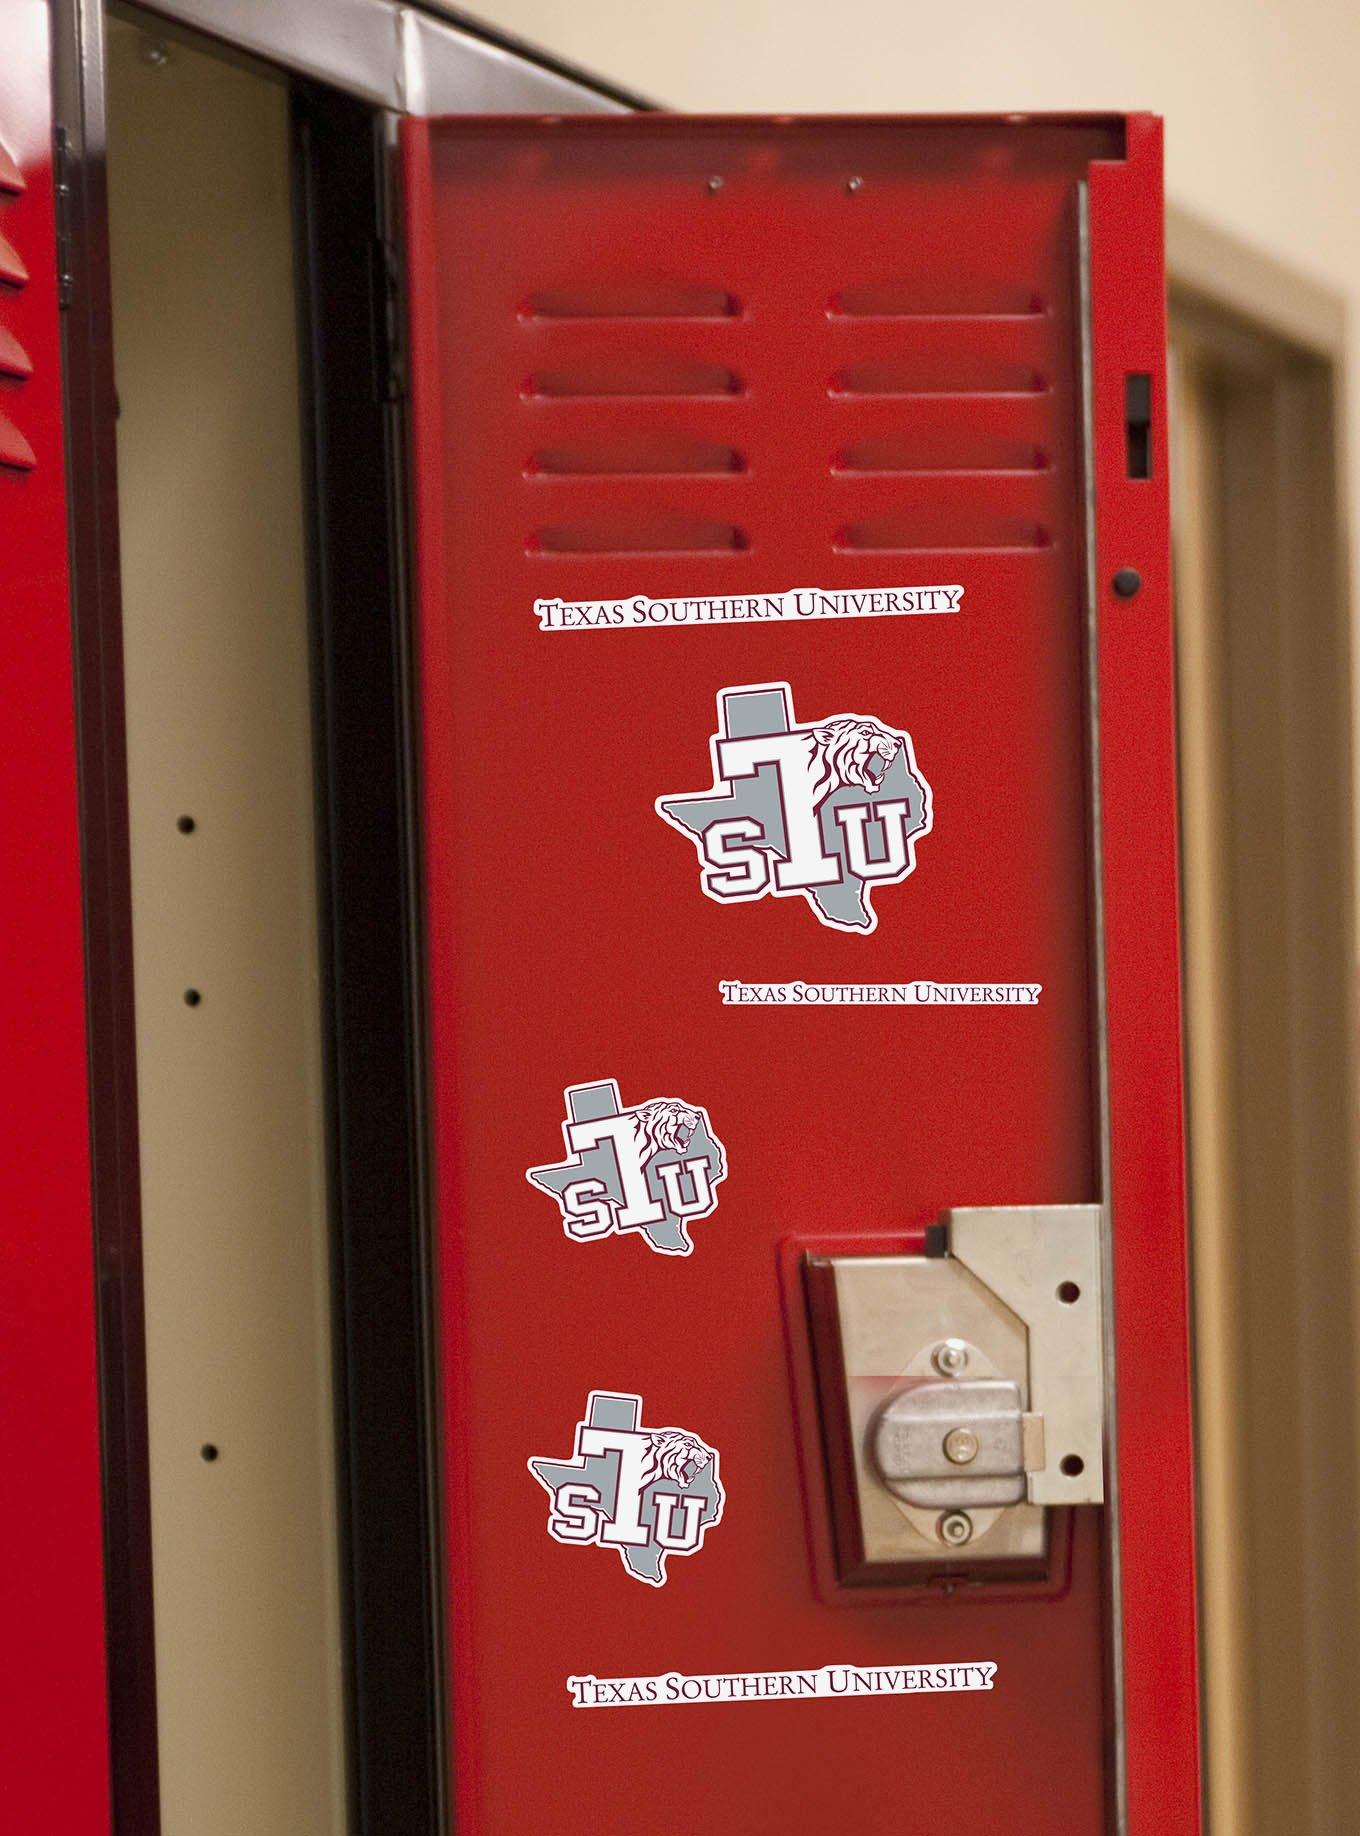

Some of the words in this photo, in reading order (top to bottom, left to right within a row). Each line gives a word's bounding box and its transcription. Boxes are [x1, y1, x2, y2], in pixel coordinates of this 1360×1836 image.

[539, 602, 625, 627] TEXAS
[633, 597, 784, 623] SOUTHERN
[793, 589, 960, 616] UNIVERSITY
[722, 984, 787, 1002] TEXAS
[792, 984, 906, 1002] SOUTHERN
[914, 984, 1038, 1002] UNIVERSITY
[572, 1679, 657, 1704] TEXAS
[666, 1674, 817, 1700] SOUTHERN
[826, 1666, 993, 1693] UNIVERSITY
